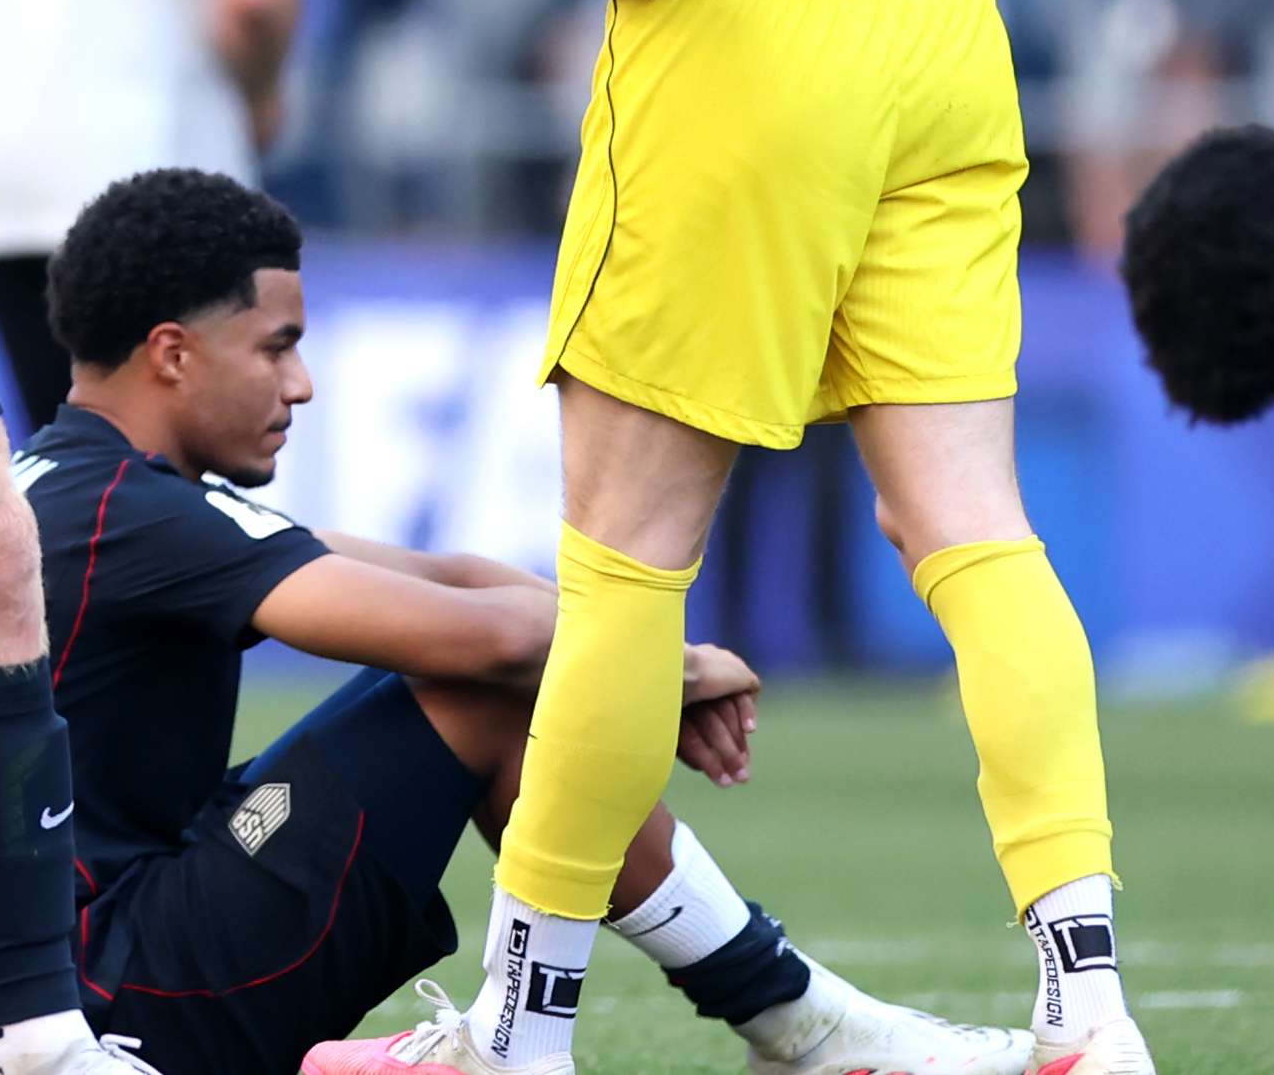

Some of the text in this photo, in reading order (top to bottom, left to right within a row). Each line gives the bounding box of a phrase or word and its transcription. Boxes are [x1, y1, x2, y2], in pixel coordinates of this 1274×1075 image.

[232, 810, 263, 849] USA
[491, 958, 523, 1059] TAPEDESIGN
[1035, 928, 1064, 1028] TAPEDESIGN
